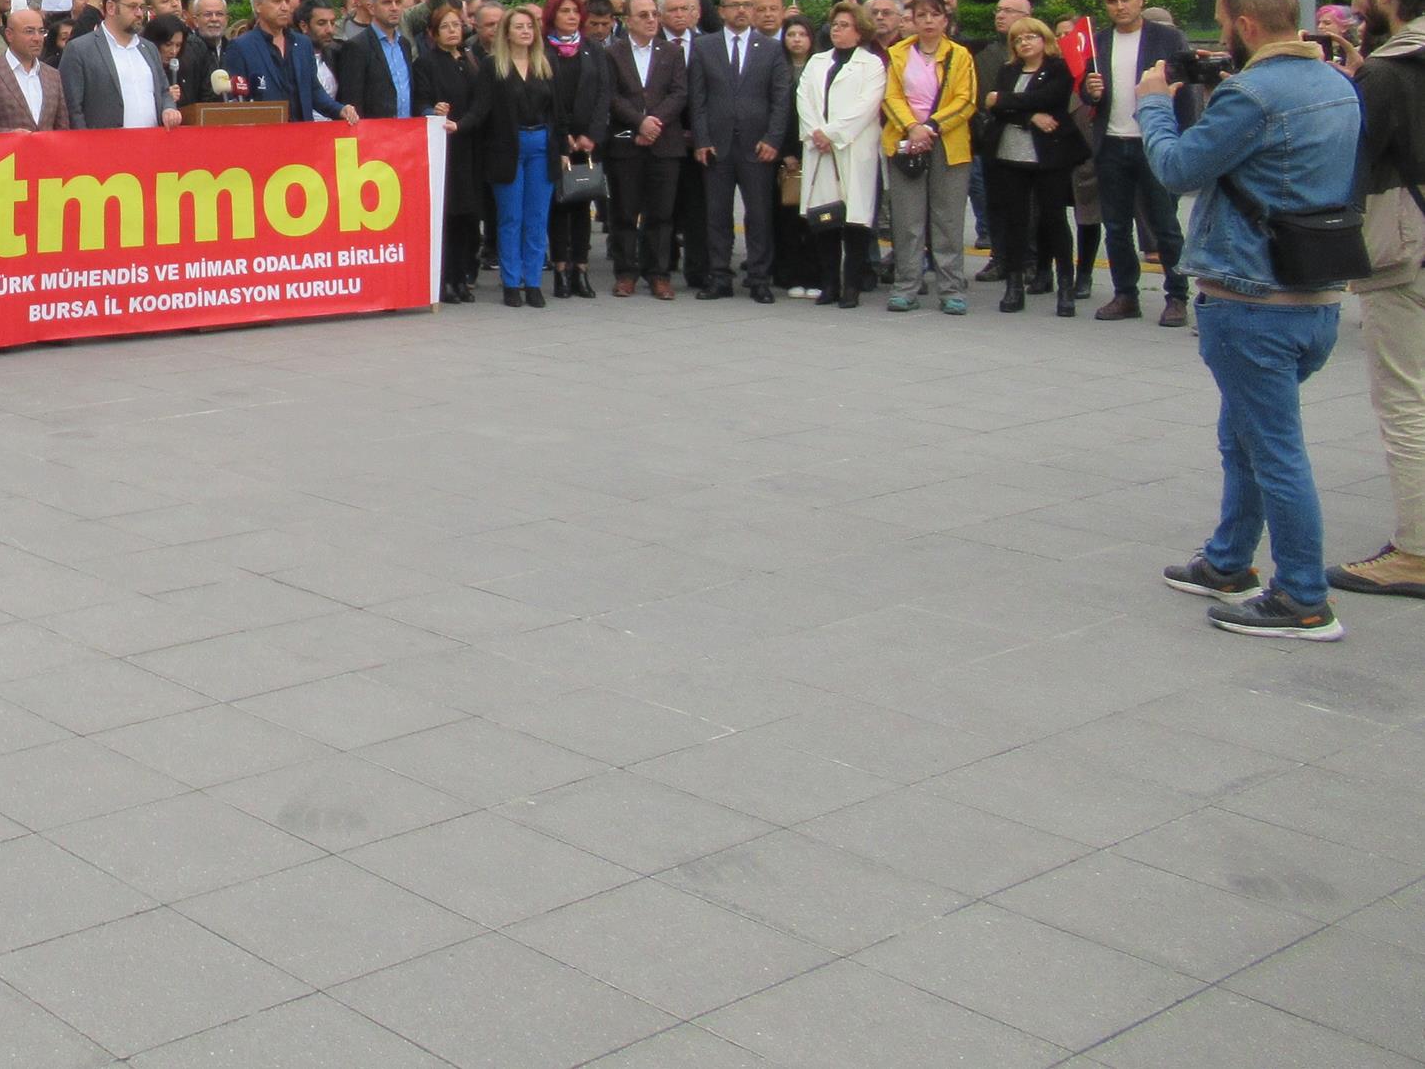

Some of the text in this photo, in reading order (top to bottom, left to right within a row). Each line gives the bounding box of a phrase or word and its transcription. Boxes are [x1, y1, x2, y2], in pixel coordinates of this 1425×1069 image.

[40, 263, 150, 291] MÜHENDİS
[154, 263, 179, 281] VE
[185, 258, 248, 279] MİMAR
[252, 252, 332, 273] ODALARI
[337, 243, 405, 267] BİRLİĞİ
[28, 278, 361, 322] BURSA İL KOORDİNASYON KURULU
